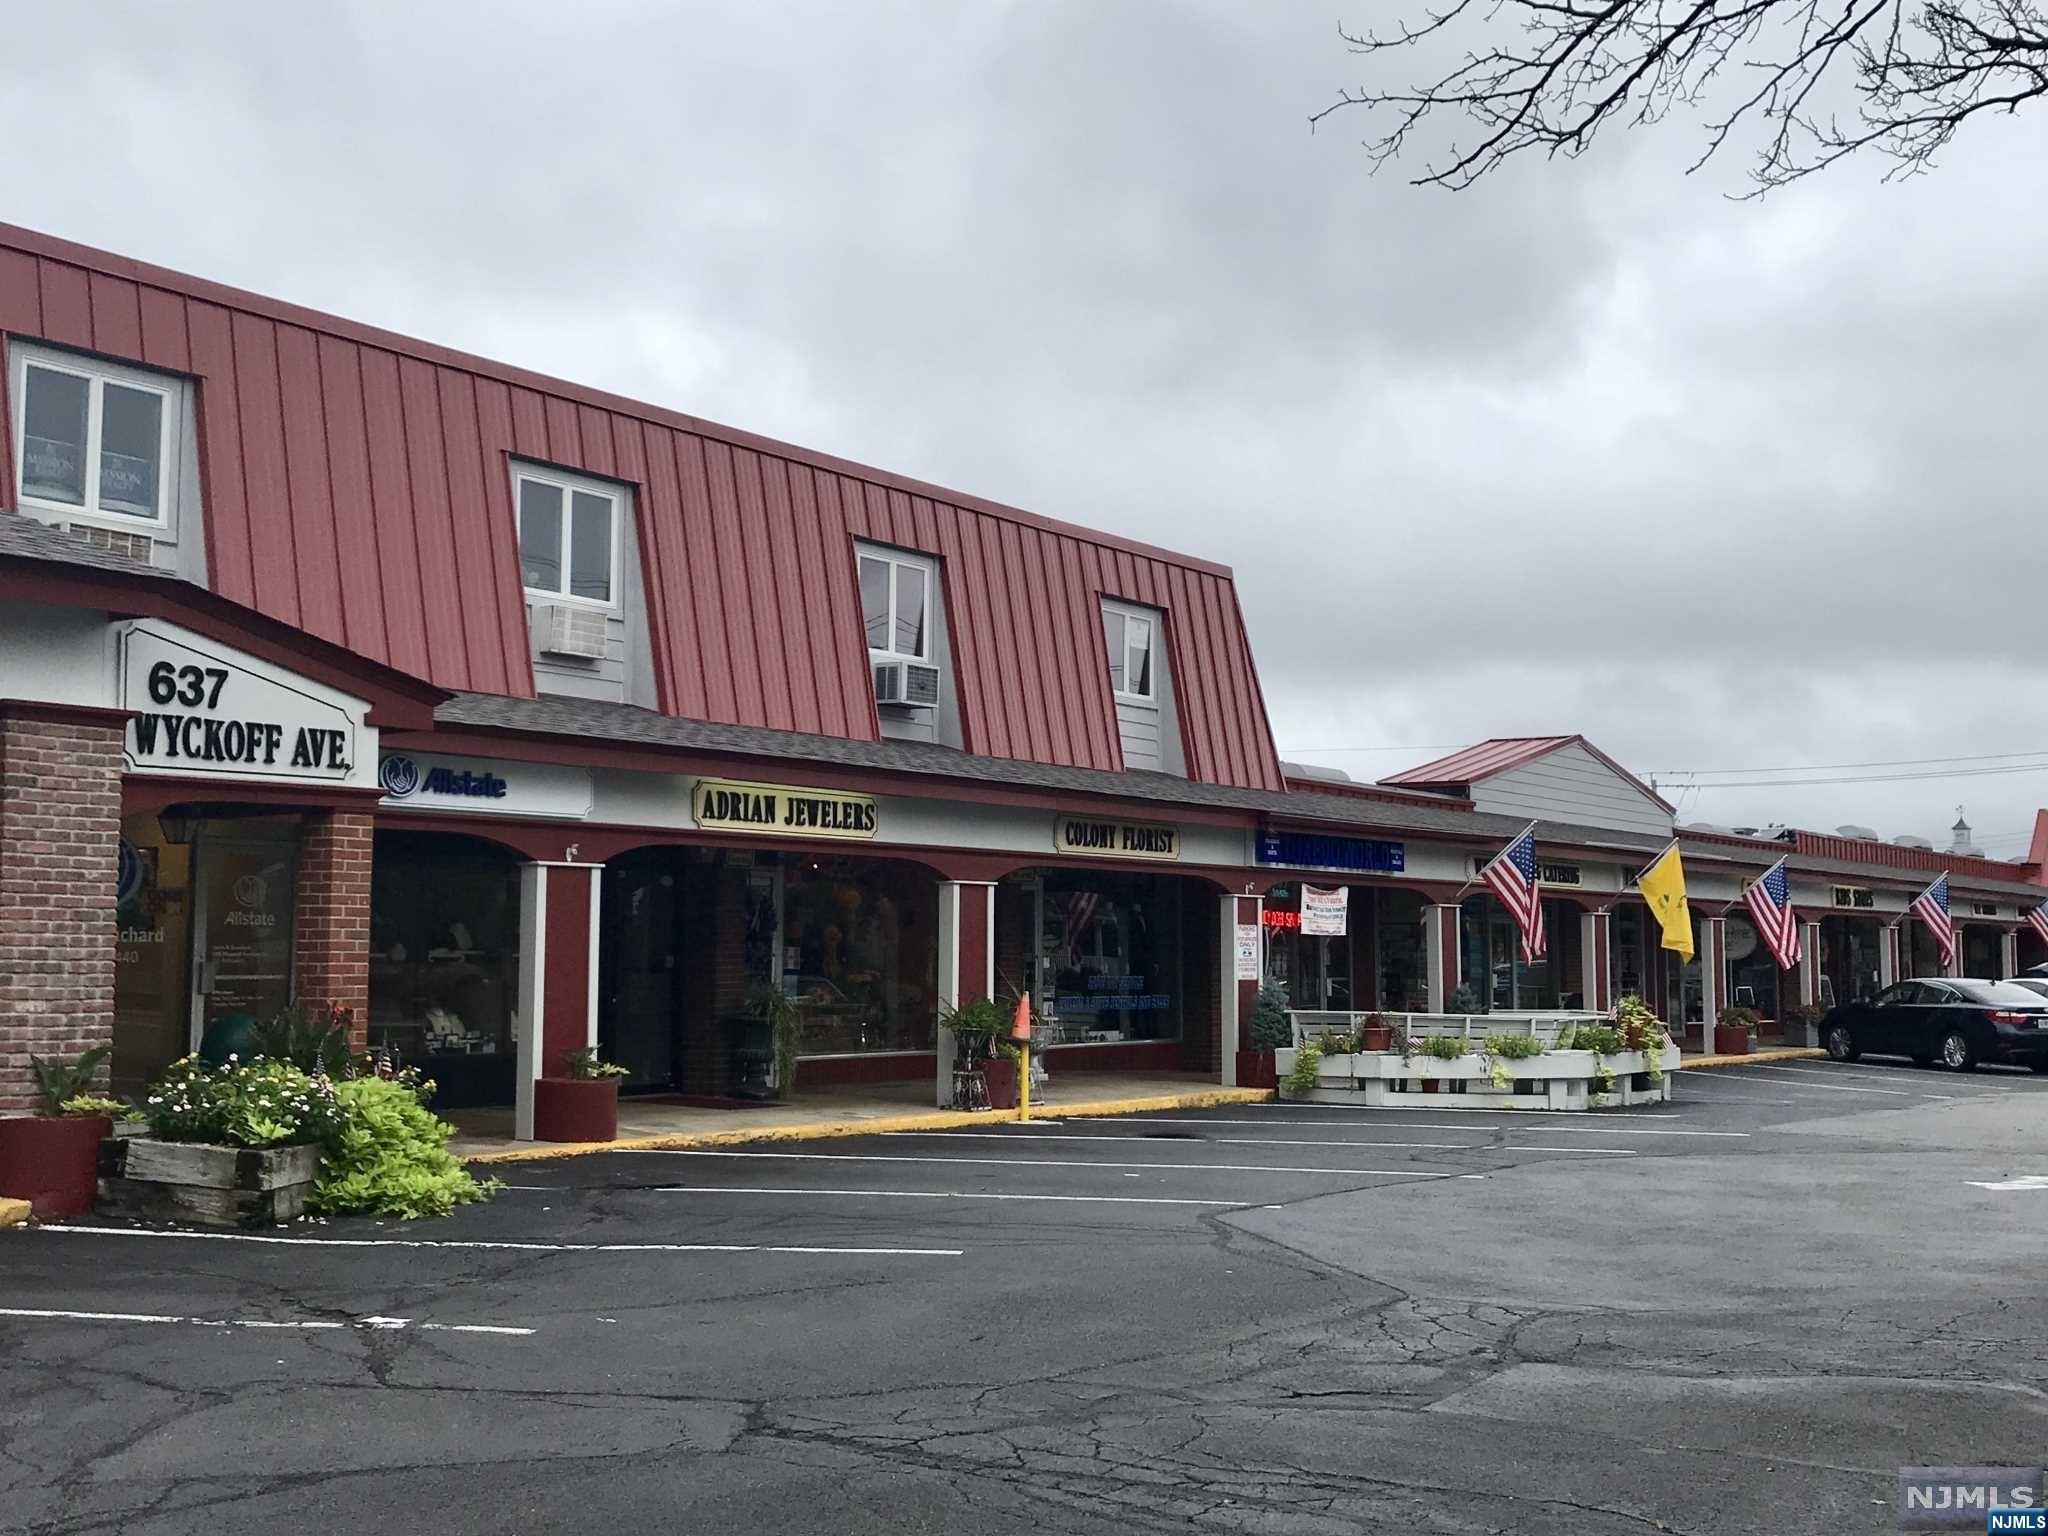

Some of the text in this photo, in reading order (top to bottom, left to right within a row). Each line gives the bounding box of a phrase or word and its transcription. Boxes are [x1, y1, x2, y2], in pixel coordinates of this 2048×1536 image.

[149, 661, 229, 709] 637
[134, 713, 282, 763] WYCKOFF
[421, 767, 507, 798] Allstate
[702, 790, 875, 831] ADRIAN JEWELERS
[1065, 821, 1174, 853] COLONY FLORIST
[223, 911, 276, 927] Allstate
